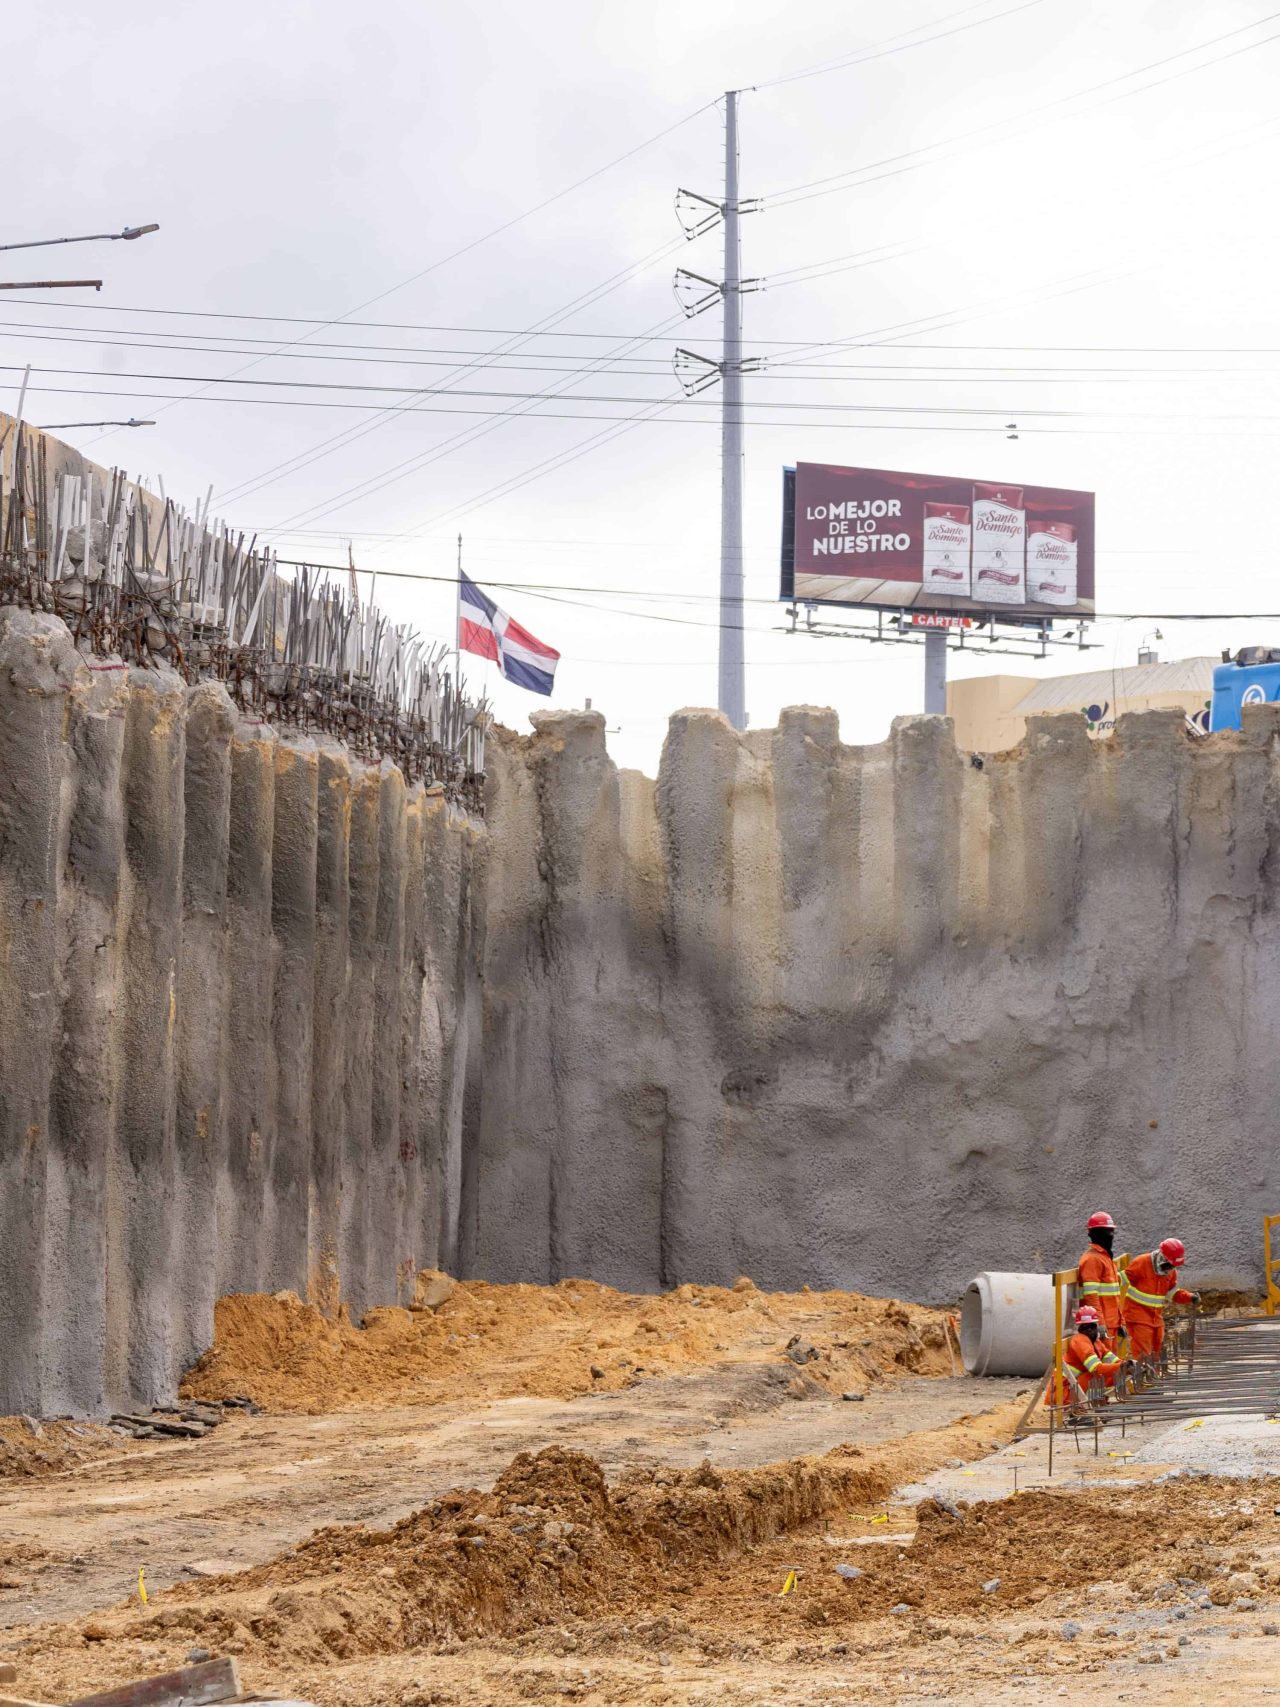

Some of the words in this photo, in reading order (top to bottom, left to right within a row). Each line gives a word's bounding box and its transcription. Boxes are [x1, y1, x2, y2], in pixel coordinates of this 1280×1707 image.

[807, 506, 827, 520] LO
[829, 499, 902, 520] MEJOR
[986, 510, 1018, 524] Santo
[829, 521, 848, 535] DE
[857, 519, 876, 533] LO
[937, 524, 964, 536] Santo
[976, 517, 1022, 538] Domingo
[813, 533, 911, 556] NUESTRO
[918, 614, 964, 628] CARTEL
